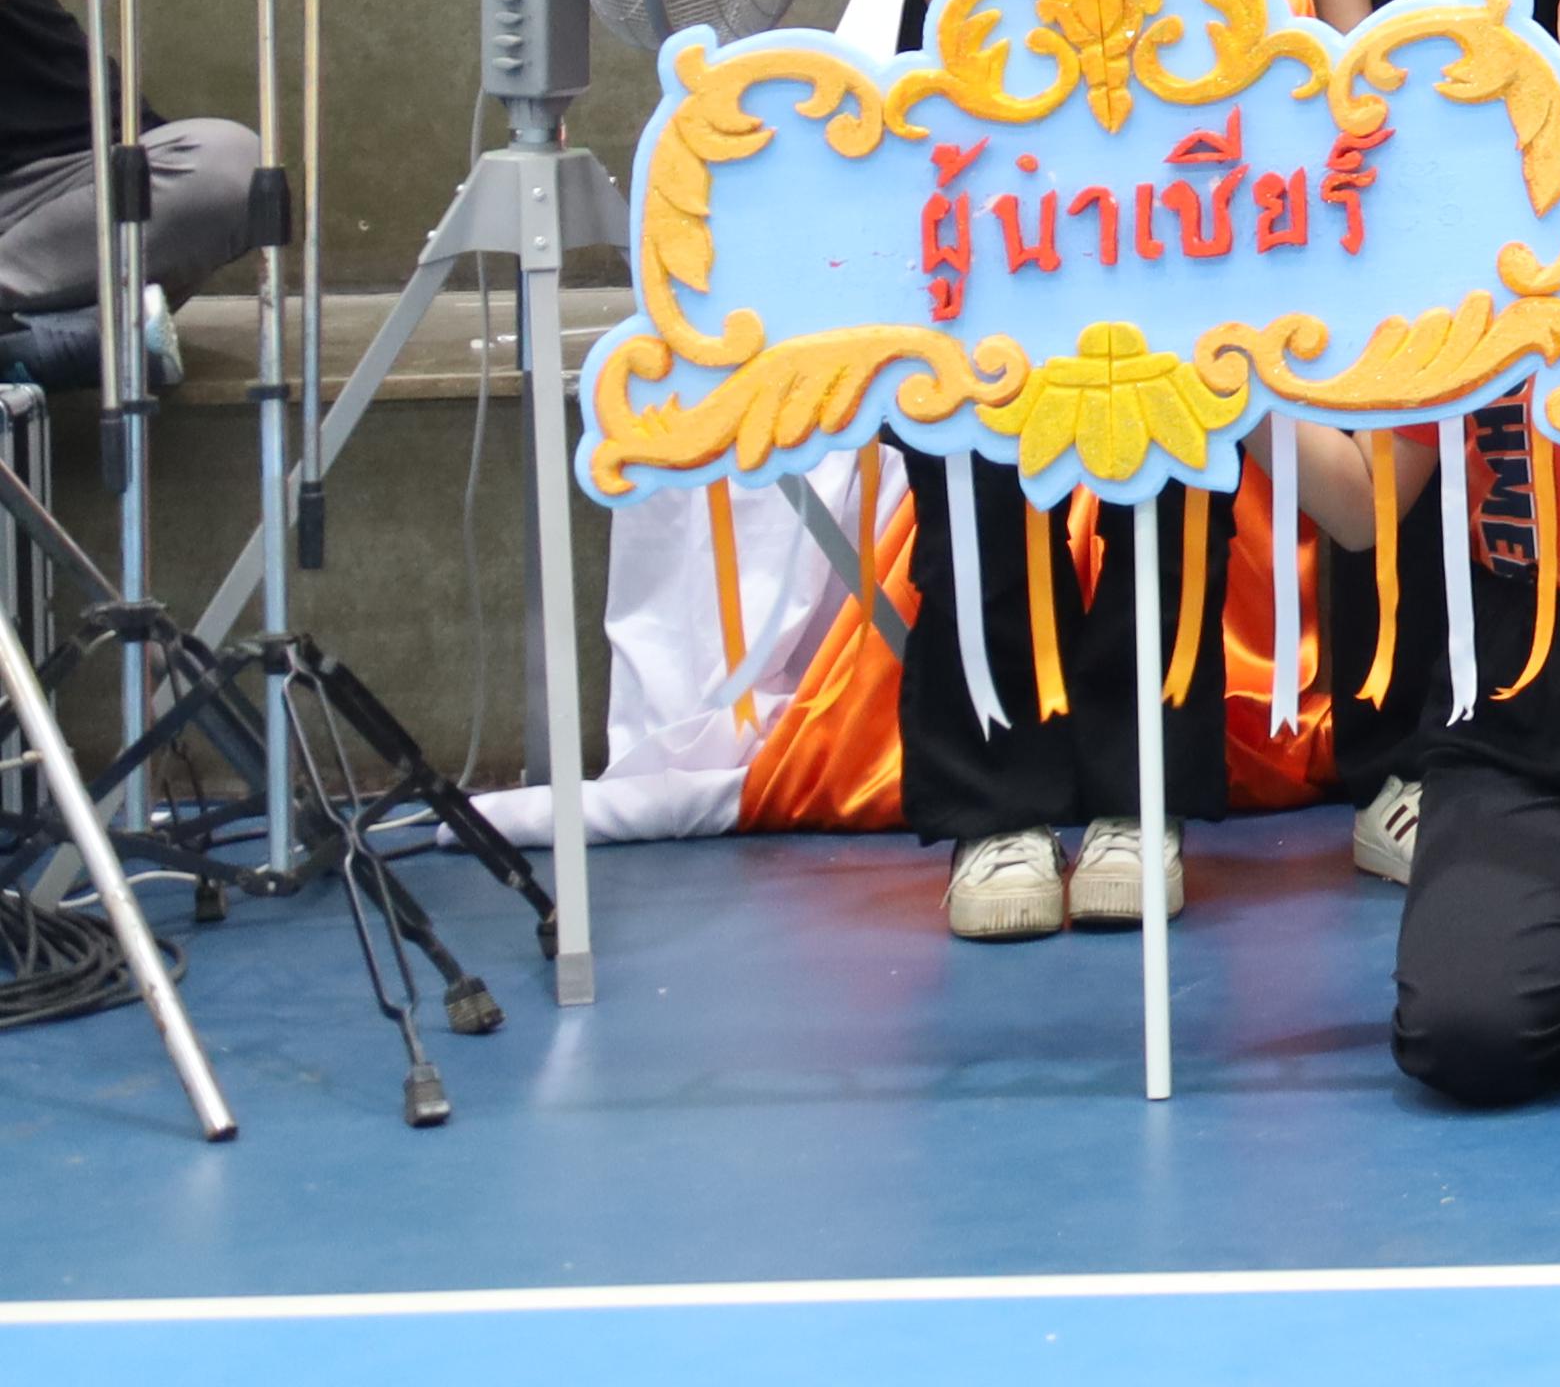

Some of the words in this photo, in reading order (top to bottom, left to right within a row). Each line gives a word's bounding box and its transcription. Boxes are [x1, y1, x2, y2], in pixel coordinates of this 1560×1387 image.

[920, 104, 1396, 322] ผู้นำเชียร์
